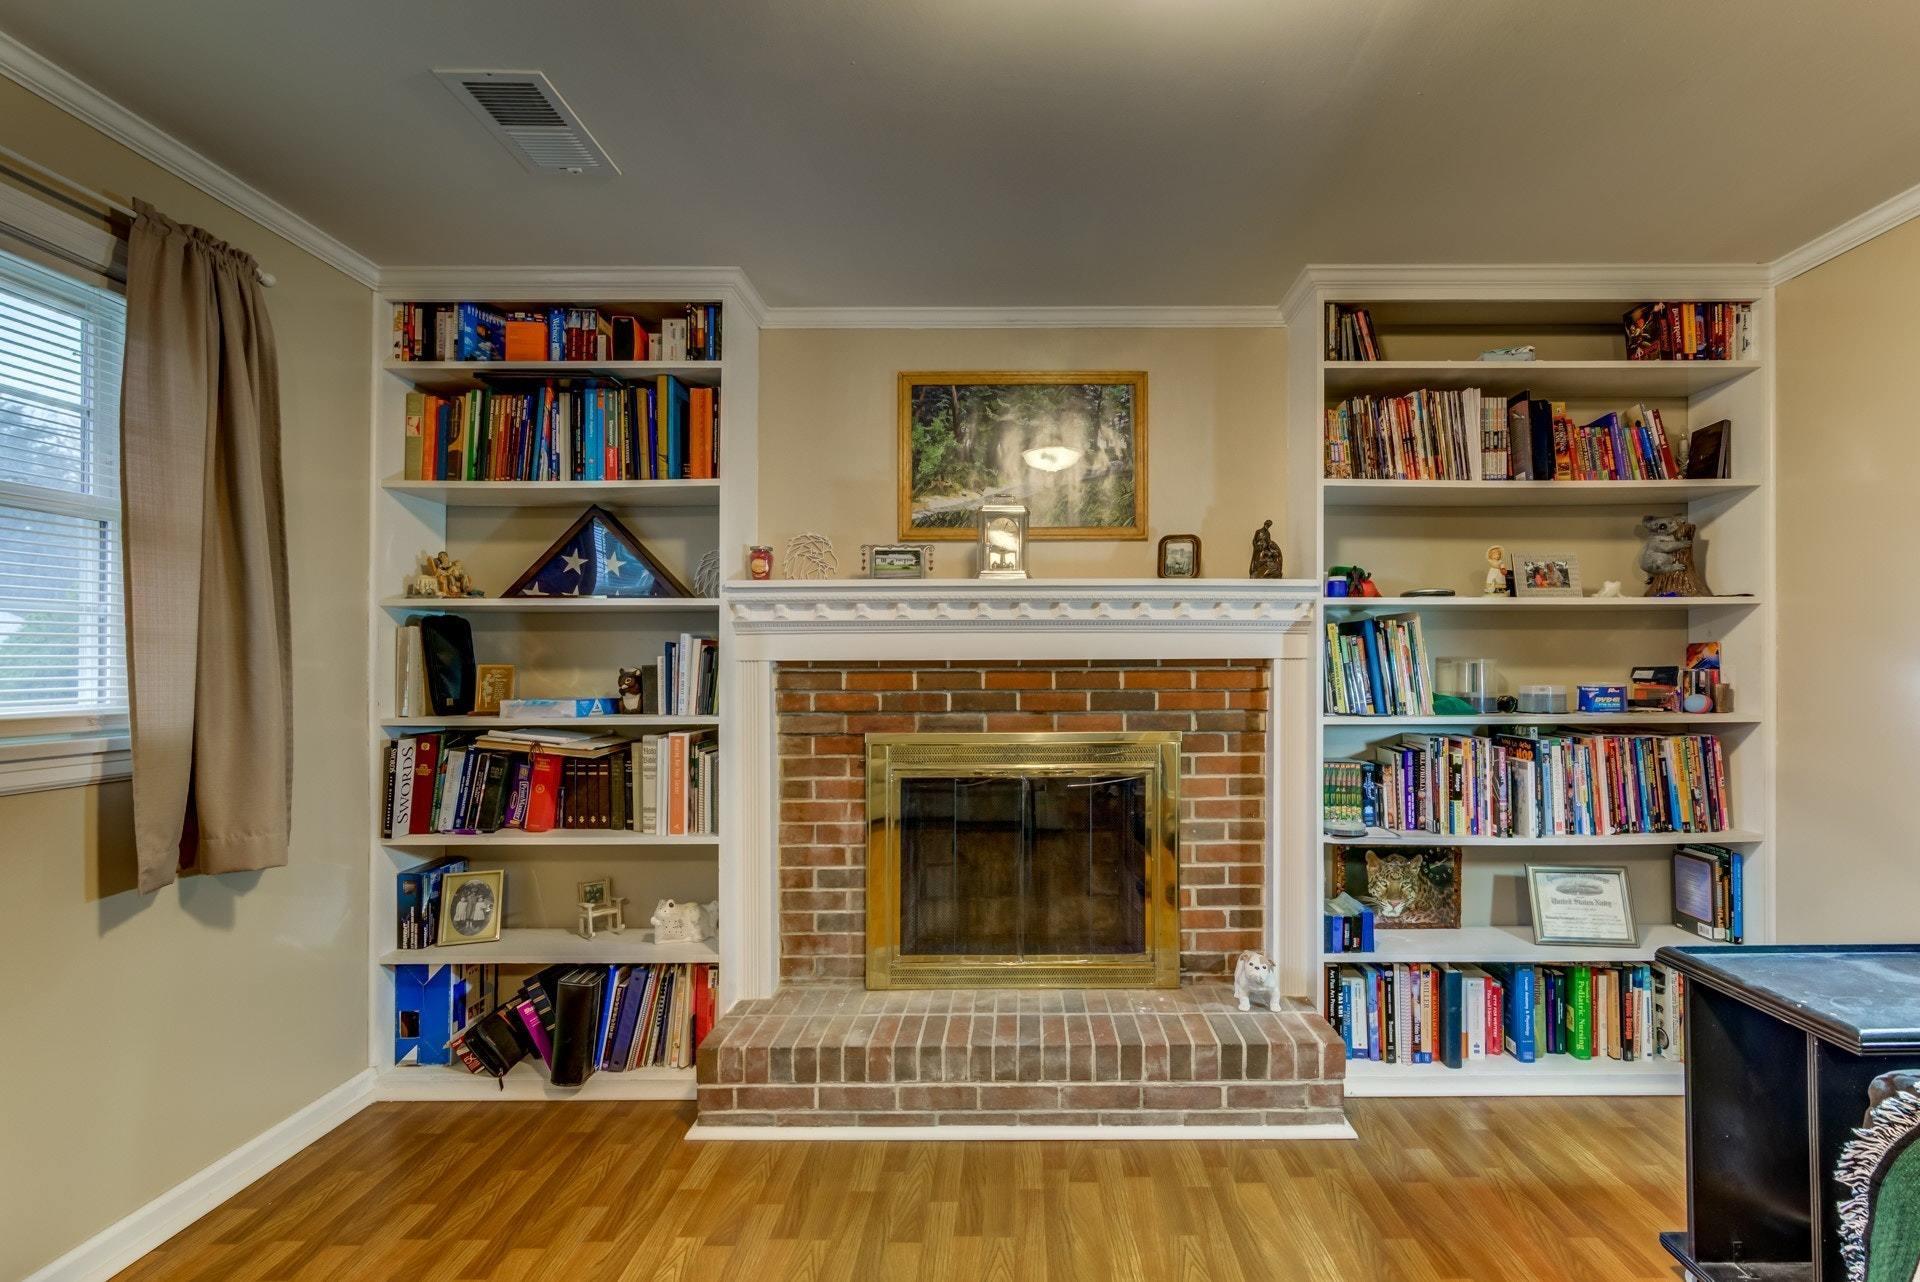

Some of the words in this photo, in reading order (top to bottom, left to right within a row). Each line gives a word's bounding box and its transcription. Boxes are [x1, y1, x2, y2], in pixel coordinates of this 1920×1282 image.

[397, 745, 414, 825] SWORDS
[1578, 981, 1586, 1017] Pediatric
[1625, 992, 1633, 1017] Graphic
[1576, 1018, 1586, 1050] Nursing
[1625, 1017, 1633, 1040] Design
